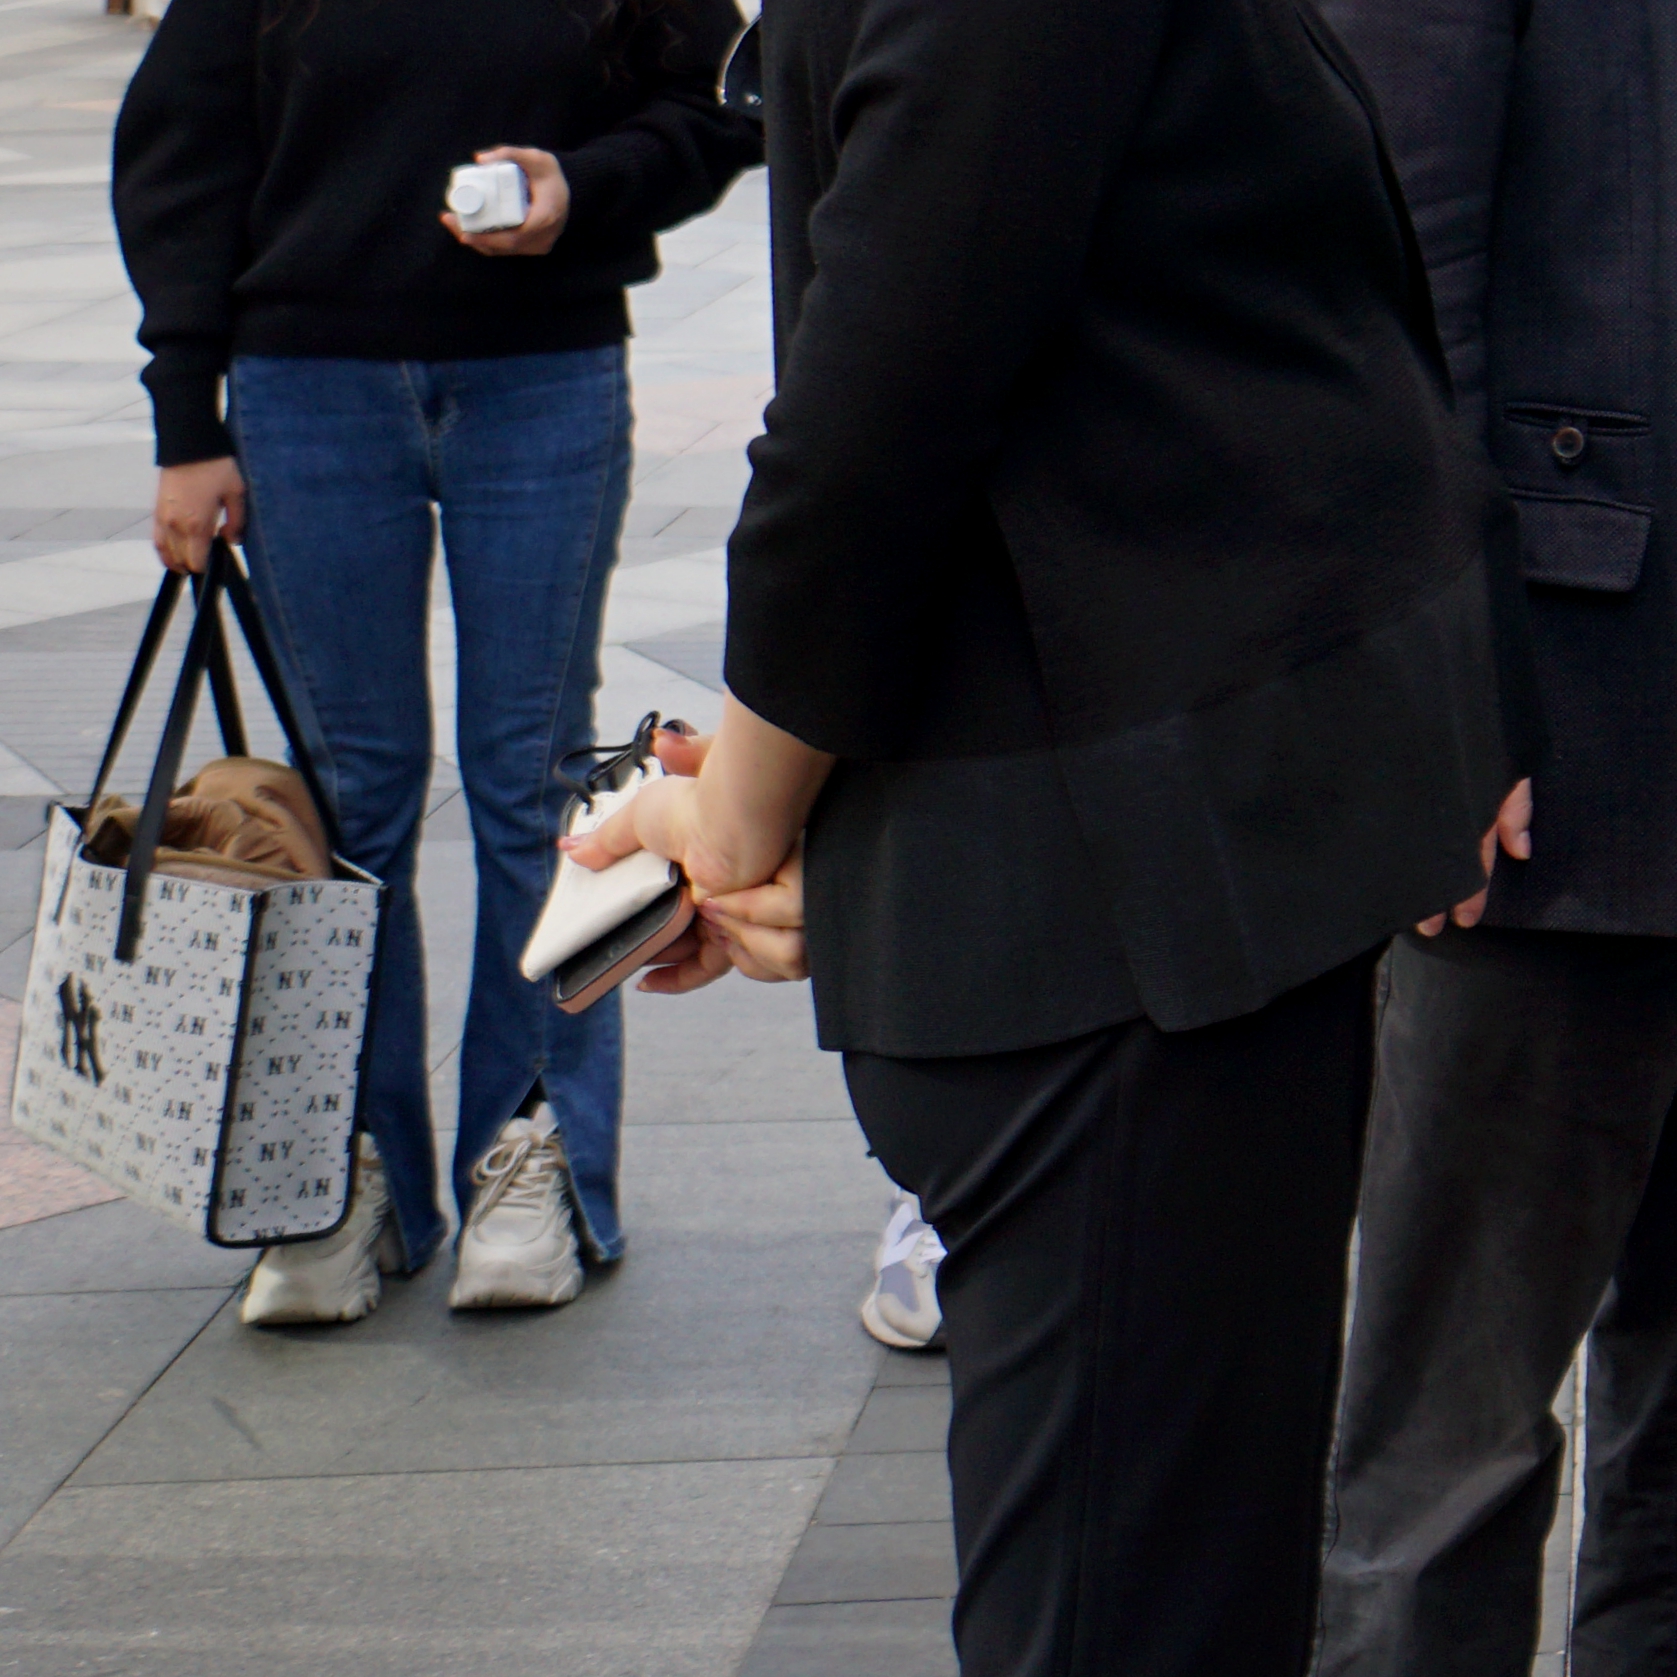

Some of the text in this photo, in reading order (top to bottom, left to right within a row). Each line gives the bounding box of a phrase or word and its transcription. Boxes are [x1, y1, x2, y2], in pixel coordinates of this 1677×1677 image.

[160, 880, 190, 903] NY
[289, 885, 324, 906] NY
[145, 965, 178, 988] NY
[277, 969, 314, 991] NY
[135, 1049, 163, 1072] NY
[268, 1054, 303, 1076] NY
[259, 1140, 295, 1162] NY
